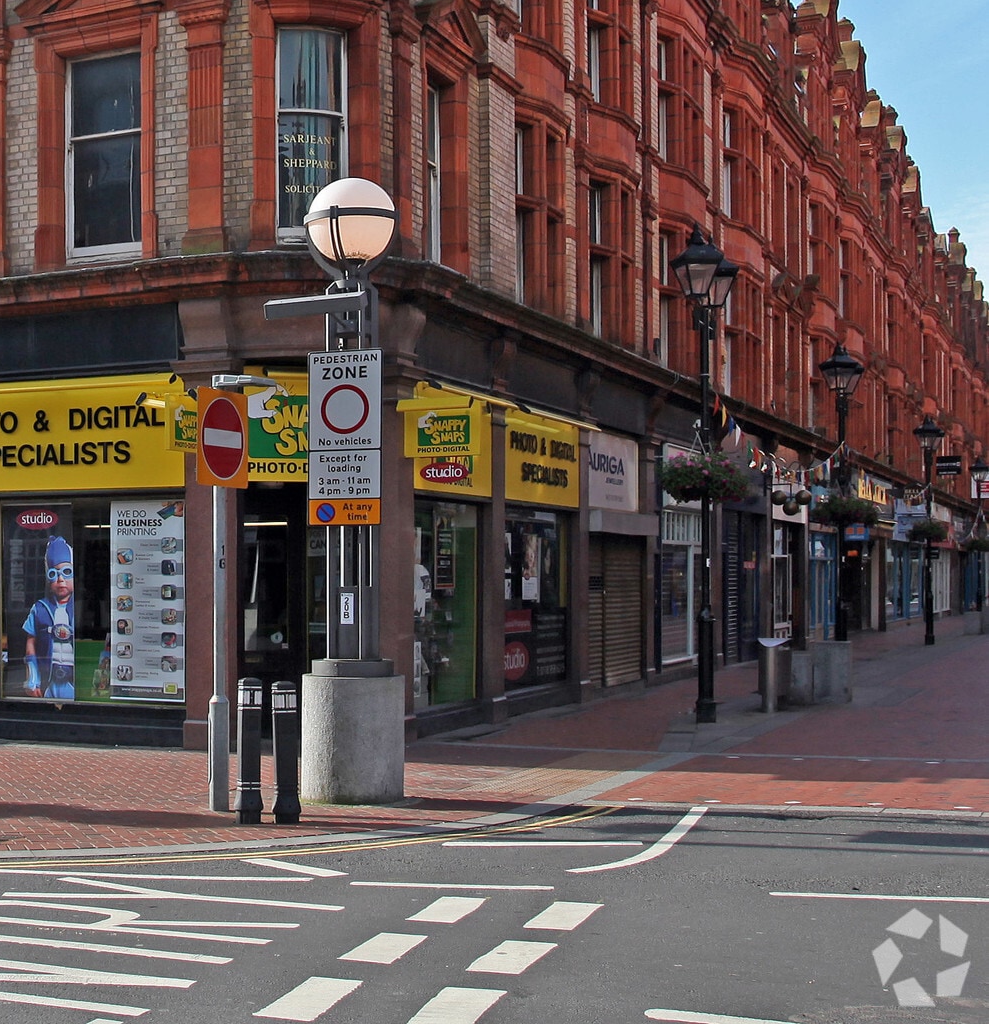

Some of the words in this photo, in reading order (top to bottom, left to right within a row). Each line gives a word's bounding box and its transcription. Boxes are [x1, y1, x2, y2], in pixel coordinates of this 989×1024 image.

[283, 134, 336, 146] SARJEANT
[309, 147, 315, 156] &
[283, 158, 338, 170] SHEPPARD
[285, 184, 323, 194] SOLICIT
[313, 353, 378, 365] PEDESTRIAN
[322, 365, 368, 380] ZONE
[33, 410, 50, 432] &
[69, 405, 165, 432] DIGITAL
[424, 418, 467, 435] SNAPPY
[318, 438, 331, 446] No
[334, 437, 372, 446] vehicles
[430, 432, 466, 445] SNAPS
[510, 430, 538, 455] PHOTO
[540, 437, 547, 456] &
[550, 440, 577, 462] DIGITAL
[319, 455, 351, 463] Except
[354, 454, 367, 462] for
[328, 465, 361, 473] loading
[425, 465, 463, 478] studio
[521, 462, 568, 488] SPECIALISTS
[318, 477, 324, 485] 3
[327, 487, 341, 496] pm
[348, 486, 354, 494] 9
[356, 486, 371, 495] pm
[342, 503, 353, 511] At
[117, 510, 130, 518] WE
[132, 509, 147, 518] DO
[347, 512, 368, 520] time
[21, 513, 53, 525] studio
[117, 519, 163, 527] BUSINESS
[117, 528, 157, 536] PRINTING
